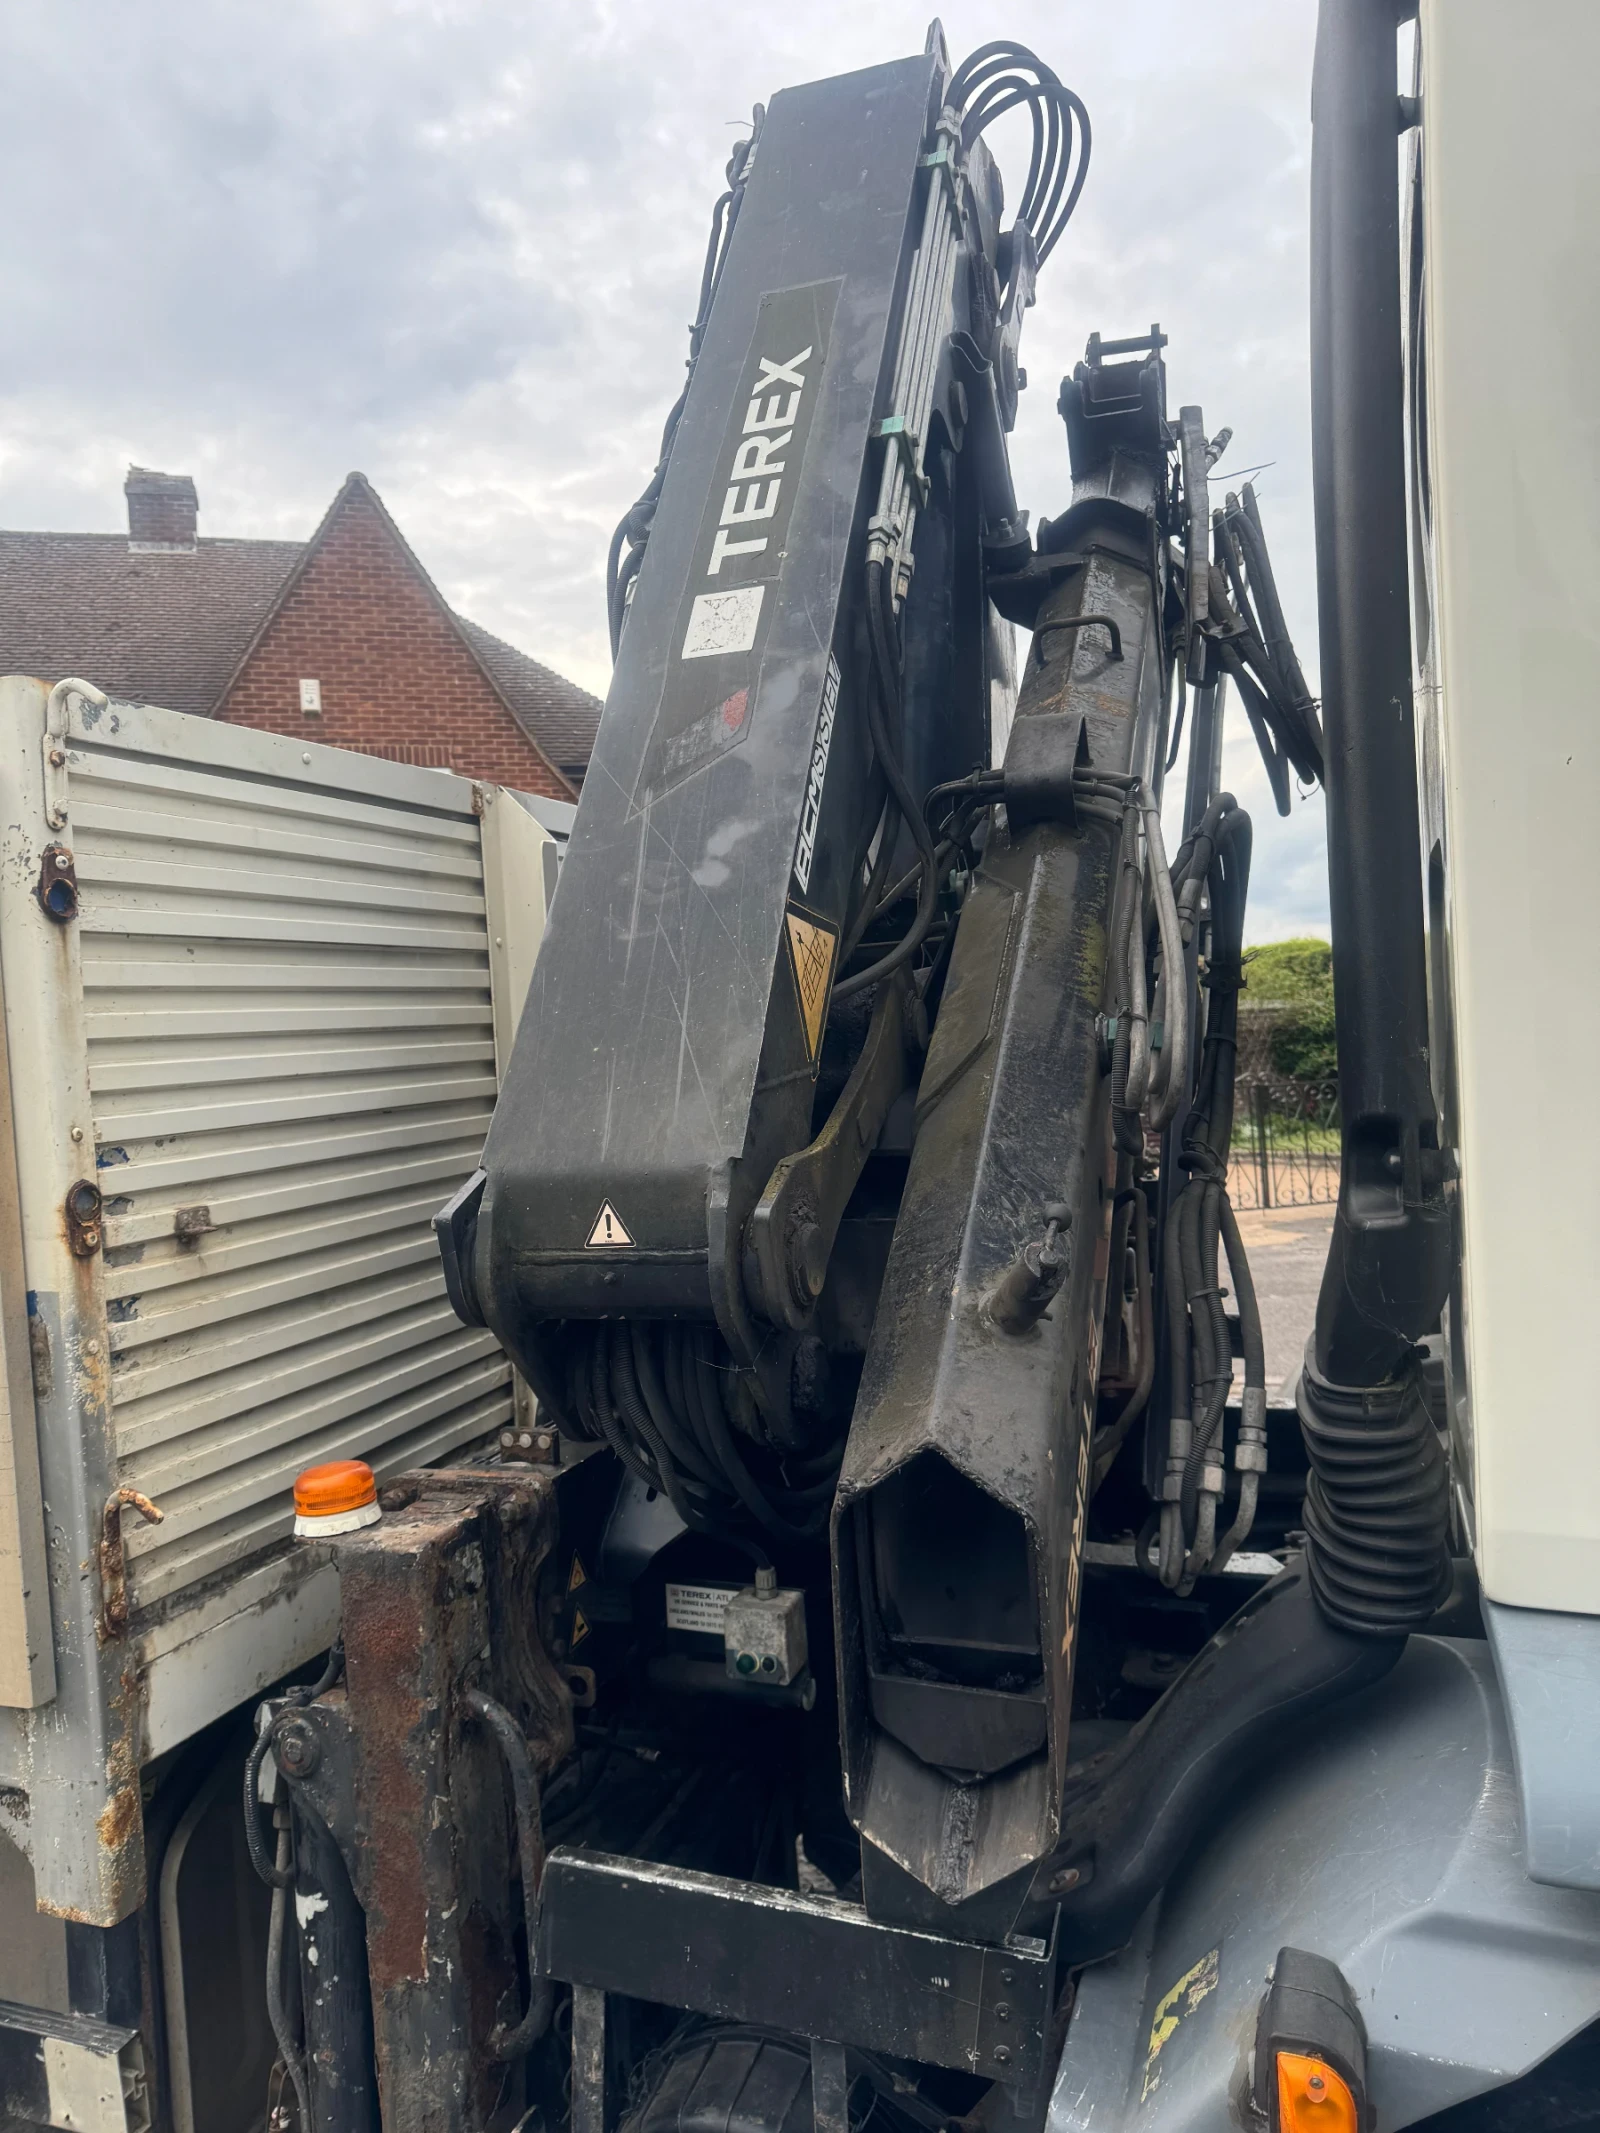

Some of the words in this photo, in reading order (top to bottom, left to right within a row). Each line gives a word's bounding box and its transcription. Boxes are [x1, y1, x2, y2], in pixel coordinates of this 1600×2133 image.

[707, 346, 812, 575] TEREX
[681, 1590, 711, 1600] TEREX
[716, 1594, 732, 1602] ATL
[1061, 1400, 1092, 1677] TEREX
